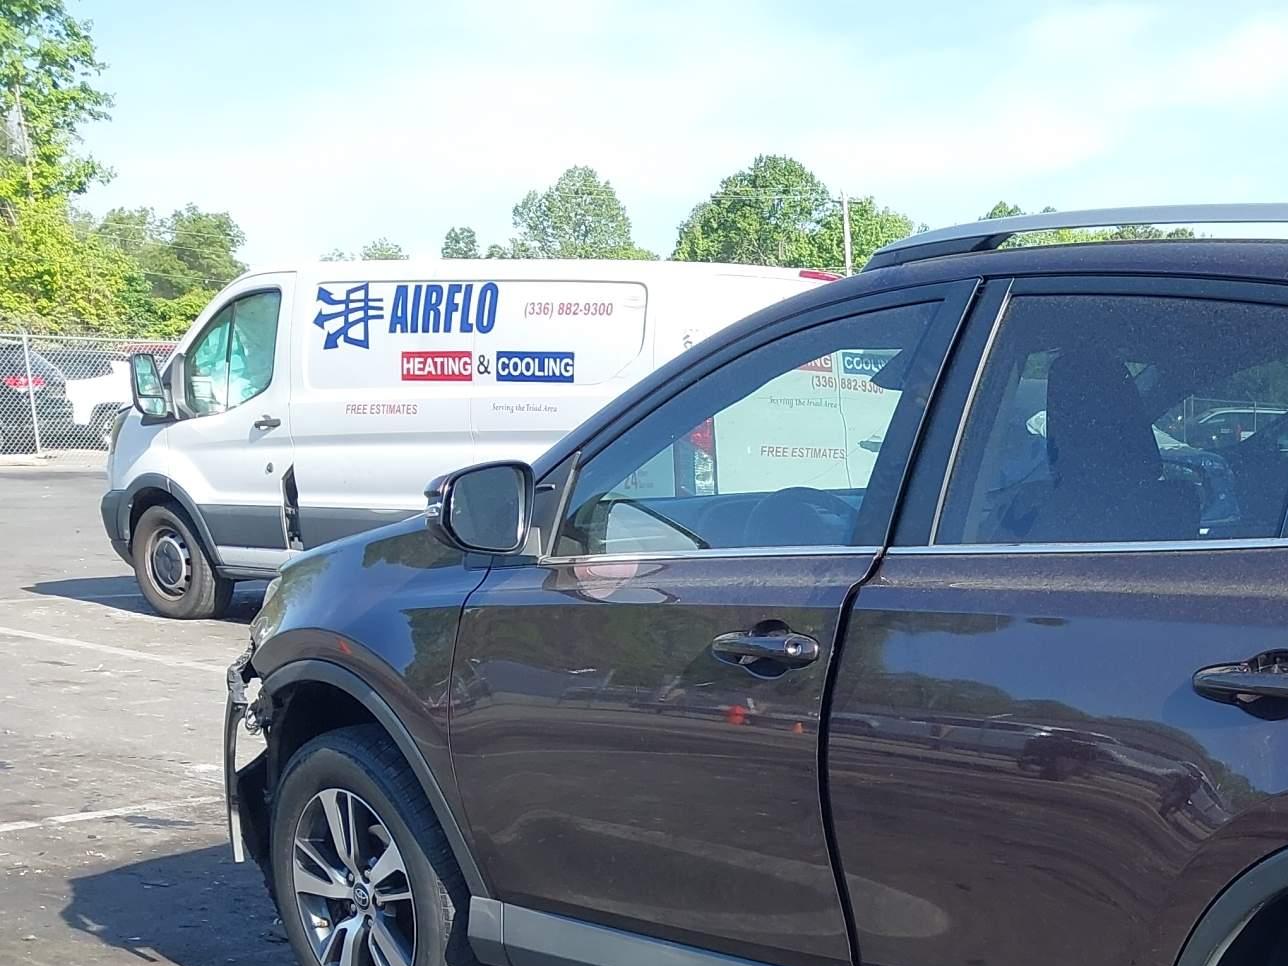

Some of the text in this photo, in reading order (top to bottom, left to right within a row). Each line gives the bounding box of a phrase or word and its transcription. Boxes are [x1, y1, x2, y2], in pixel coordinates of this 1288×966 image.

[388, 282, 499, 334] AIRFLO
[524, 302, 614, 319] (336) 882-9300
[402, 354, 574, 377] HEATING & COOLING
[811, 376, 837, 392] (336)
[345, 404, 418, 415] FREE ESTIMATES
[492, 403, 514, 413] Serving
[515, 404, 525, 412] the
[760, 446, 845, 460] FREE ESTIMATES
